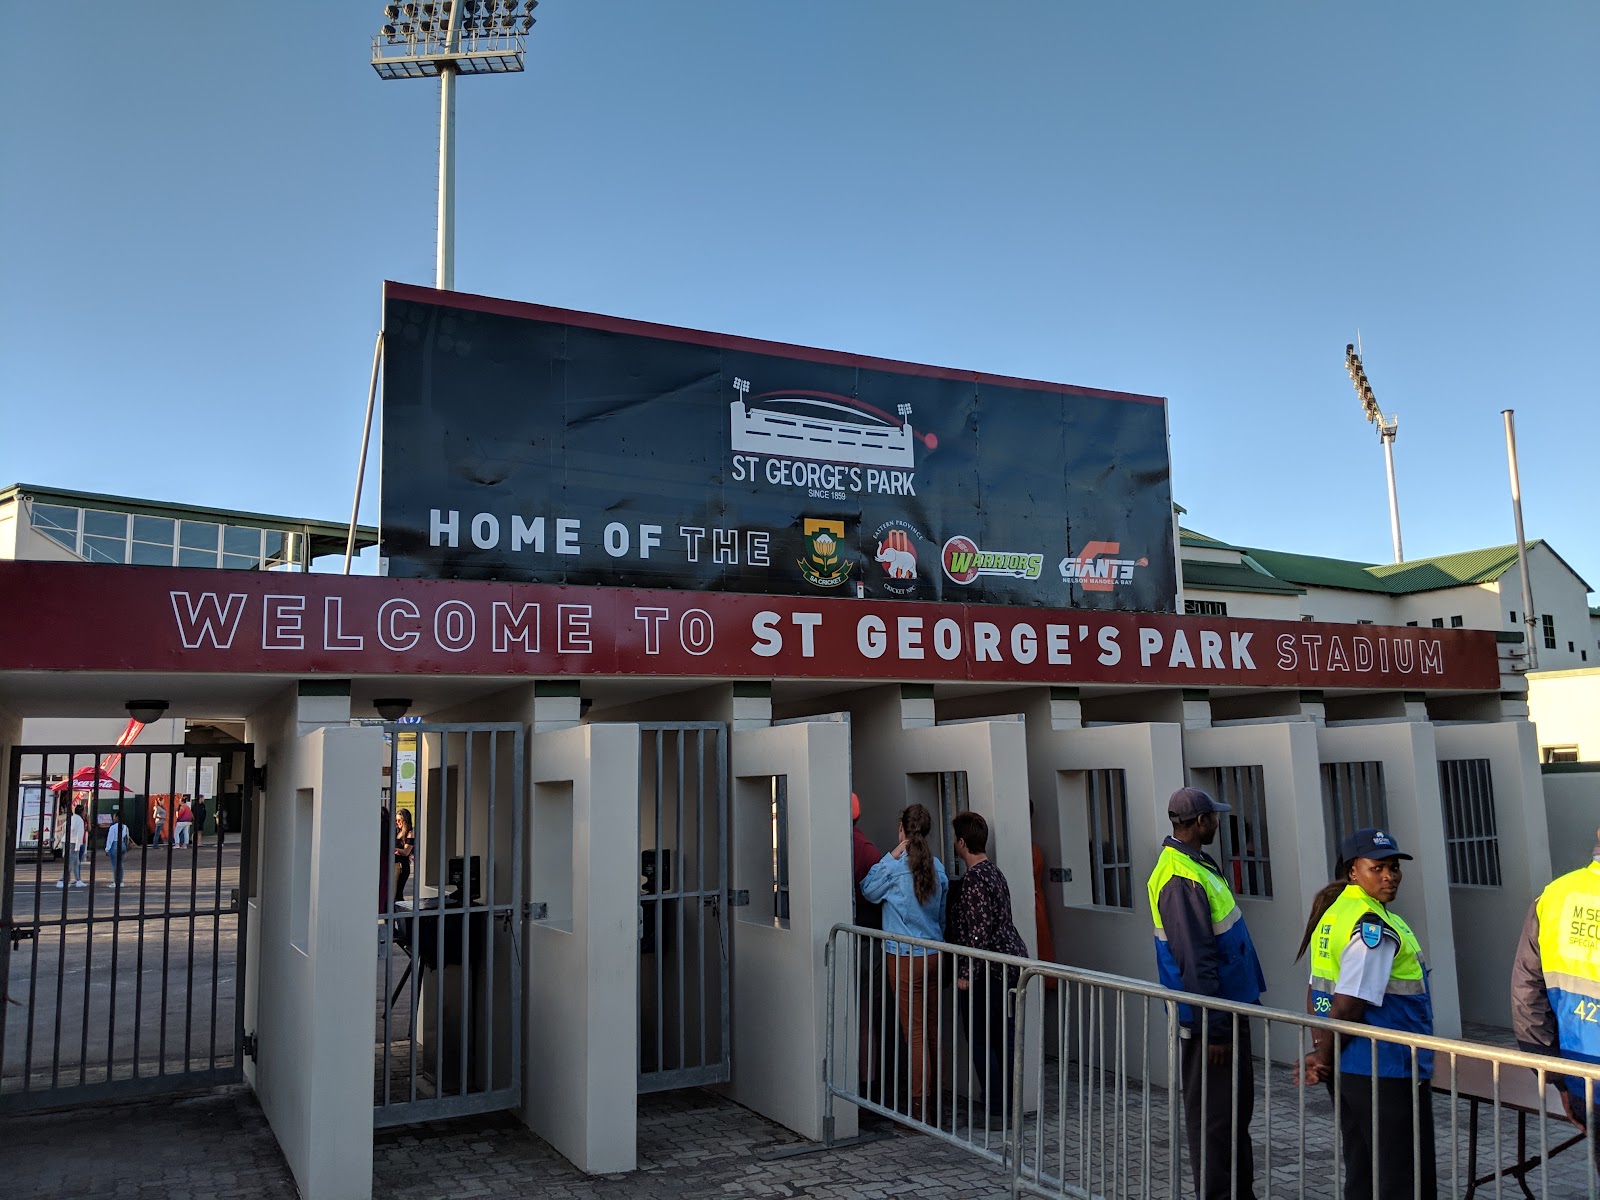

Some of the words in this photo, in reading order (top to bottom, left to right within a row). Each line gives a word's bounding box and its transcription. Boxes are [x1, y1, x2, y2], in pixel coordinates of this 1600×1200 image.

[732, 455, 760, 482] ST
[766, 458, 862, 492] GEORGE'S
[867, 469, 917, 497] PARK
[808, 489, 829, 499] SINCE
[831, 491, 846, 501] 1859
[429, 509, 581, 556] HOME
[603, 522, 662, 559] OF
[680, 526, 770, 567] THE
[872, 520, 895, 540] EASTERN
[895, 519, 924, 541] PROVINCE
[950, 551, 1042, 577] WARRIORS
[1058, 557, 1136, 579] GIANTS
[810, 575, 818, 583] SA
[818, 576, 842, 586] CRICKET
[883, 583, 906, 595] CRICKET
[169, 590, 593, 656] WELCOME
[634, 607, 715, 657] TO
[750, 611, 823, 658] ST
[856, 614, 1122, 667] GEORGE'S
[1139, 628, 1257, 670] PARK
[1276, 633, 1444, 675] STADIUM
[1573, 905, 1584, 919] M
